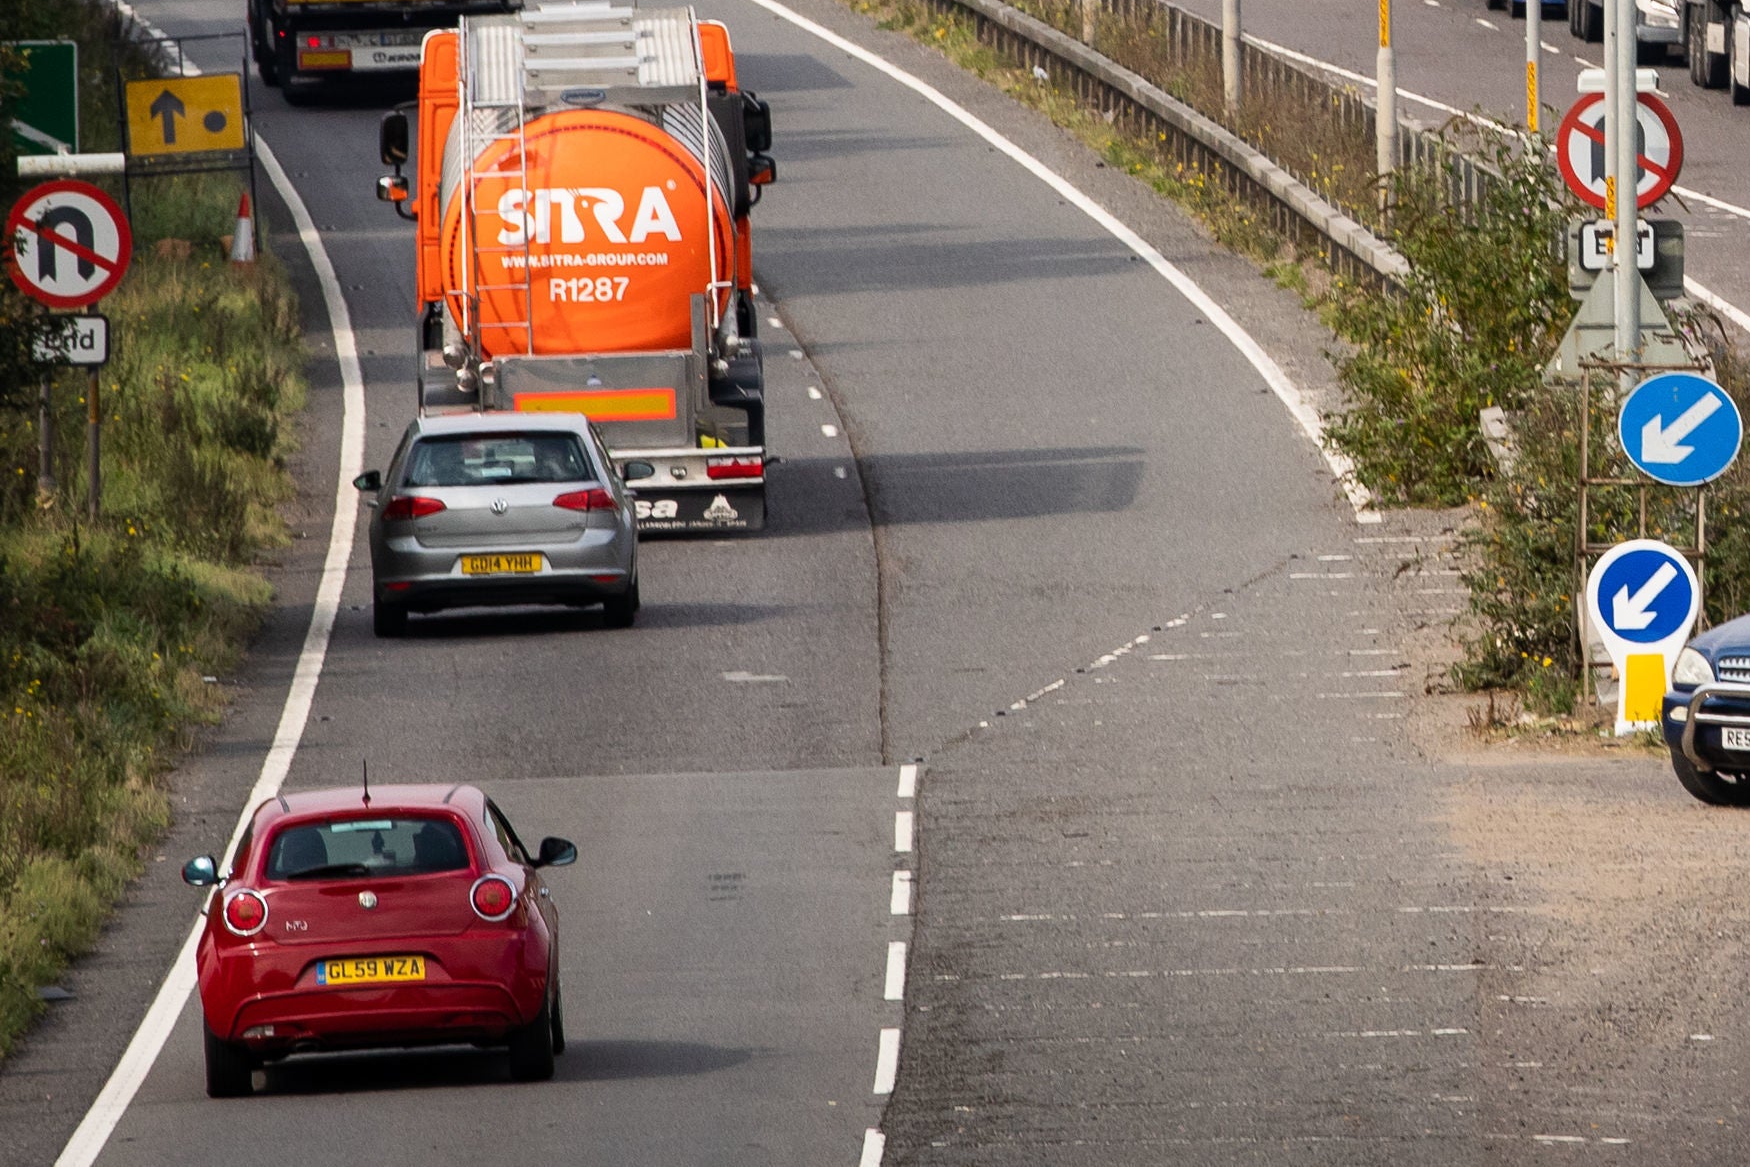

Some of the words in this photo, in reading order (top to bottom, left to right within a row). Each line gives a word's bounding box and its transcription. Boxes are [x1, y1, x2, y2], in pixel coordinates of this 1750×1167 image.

[497, 186, 682, 245] SITRA
[549, 276, 629, 302] R1287
[634, 499, 678, 519] sa
[470, 556, 501, 572] GD14
[328, 961, 378, 980] GL59
[384, 958, 421, 978] WZA
